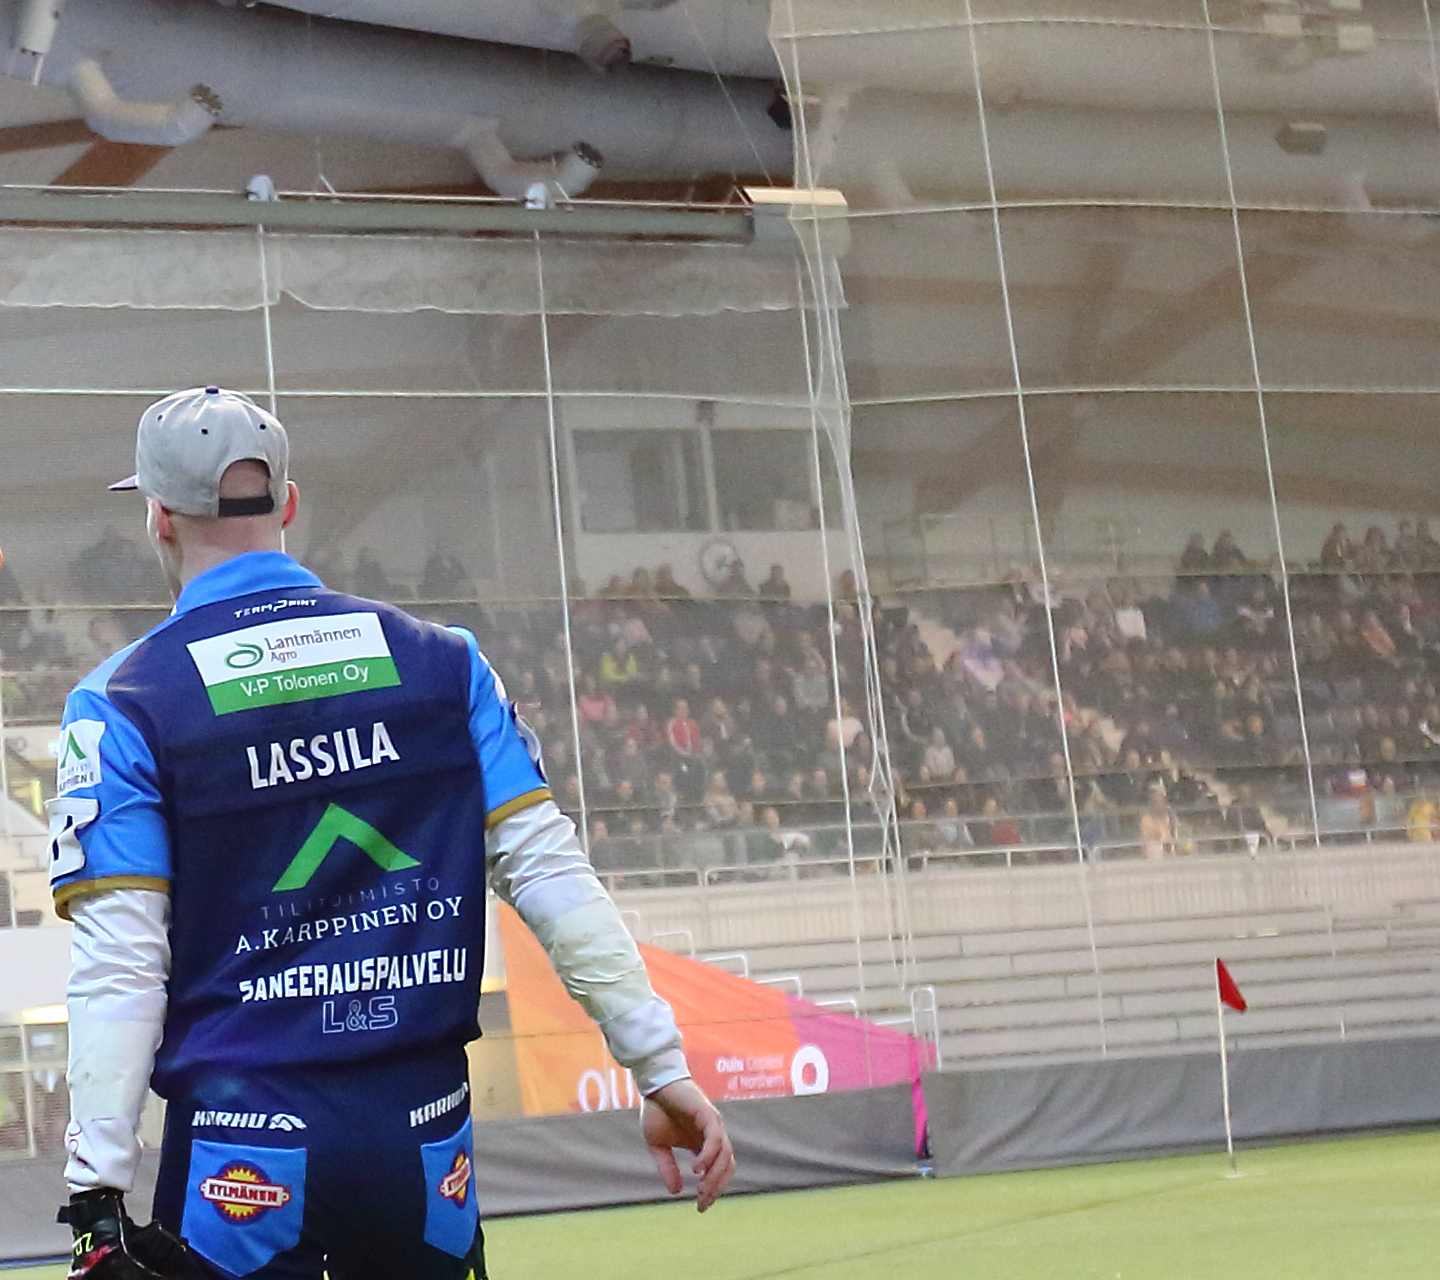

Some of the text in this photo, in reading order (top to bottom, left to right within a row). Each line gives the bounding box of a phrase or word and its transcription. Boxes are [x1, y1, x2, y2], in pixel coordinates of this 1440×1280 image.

[264, 627, 362, 650] Lantmännen
[270, 650, 298, 663] Agro
[239, 664, 369, 697] V-P Tolonen Oy
[246, 721, 401, 789] LASSILA
[235, 896, 463, 954] A.KARPPINEN OY
[238, 948, 467, 1003] SANEERAUSPALVELU
[322, 995, 398, 1034] L&S
[191, 1111, 268, 1129] KARHU
[209, 1184, 278, 1202] KYLMÄNEN
